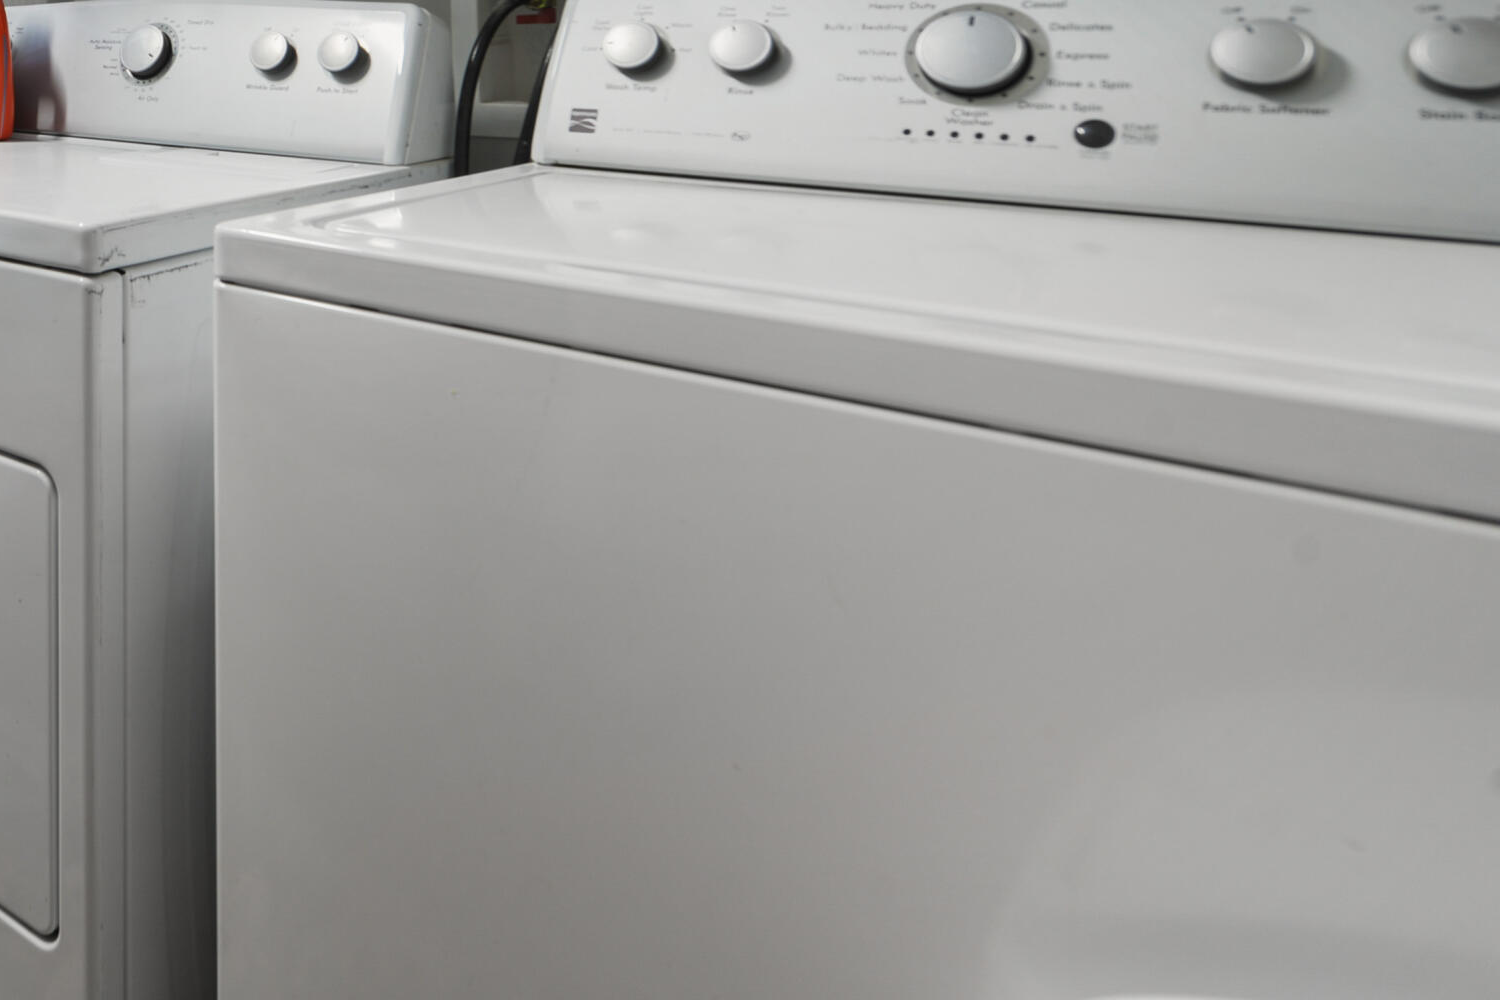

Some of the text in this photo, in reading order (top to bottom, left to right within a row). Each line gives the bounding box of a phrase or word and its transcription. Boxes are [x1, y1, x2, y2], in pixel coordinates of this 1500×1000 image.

[868, 2, 937, 11] Heavy Duty
[1021, 0, 1068, 9] Casual
[861, 23, 908, 32] Bedding
[1049, 23, 1113, 32] Delicates
[857, 49, 898, 57] Whites
[1056, 51, 1111, 61] Express
[836, 73, 905, 82] Deep Wash
[605, 82, 657, 92] Wash Temp
[1046, 79, 1082, 88] Rinse
[1102, 80, 1132, 90] Spin
[316, 86, 332, 94] Push
[727, 87, 754, 95] Rinse
[1017, 101, 1055, 110] Drain
[1072, 103, 1103, 113] Spin
[1203, 102, 1331, 116] Fabric Softener
[951, 108, 989, 118] Clean
[1417, 107, 1466, 120] Stain
[945, 117, 995, 127] Washer
